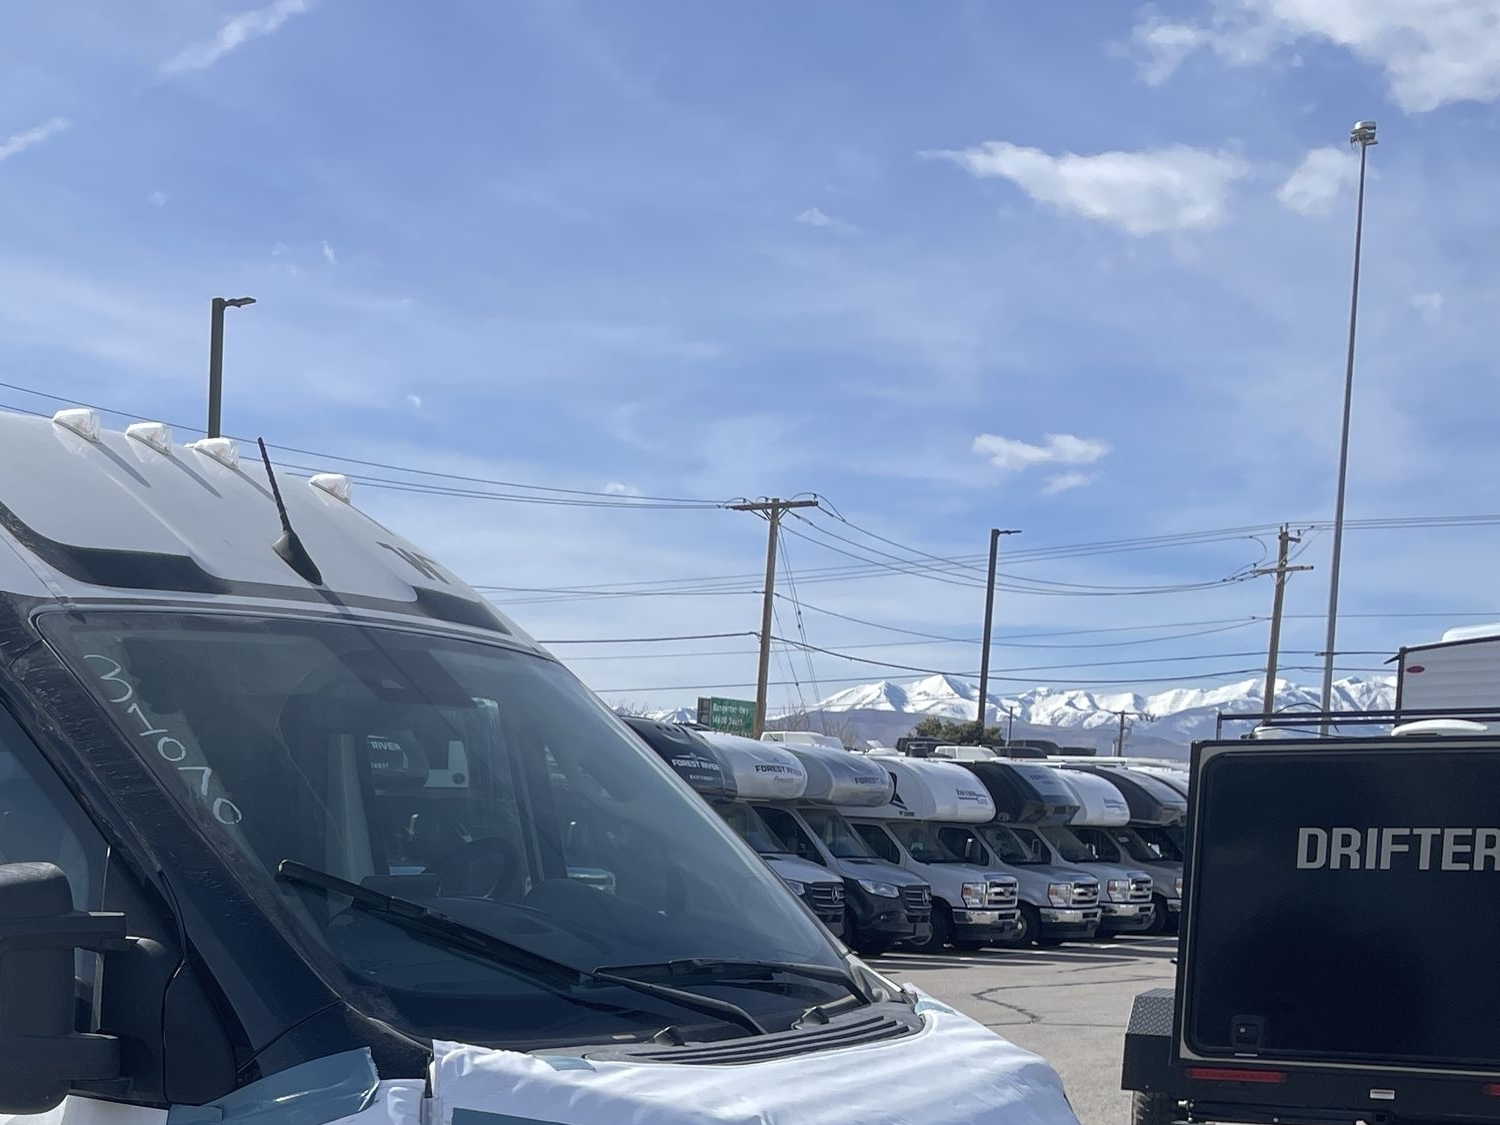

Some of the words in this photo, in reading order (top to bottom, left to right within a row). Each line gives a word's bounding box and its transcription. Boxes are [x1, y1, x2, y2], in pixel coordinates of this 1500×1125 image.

[83, 654, 242, 825] 31070
[370, 741, 401, 752] RIVER
[671, 759, 699, 769] FOREST
[700, 761, 720, 771] RIVER
[755, 765, 785, 773] FOREST
[1296, 827, 1500, 871] DRIFTER
